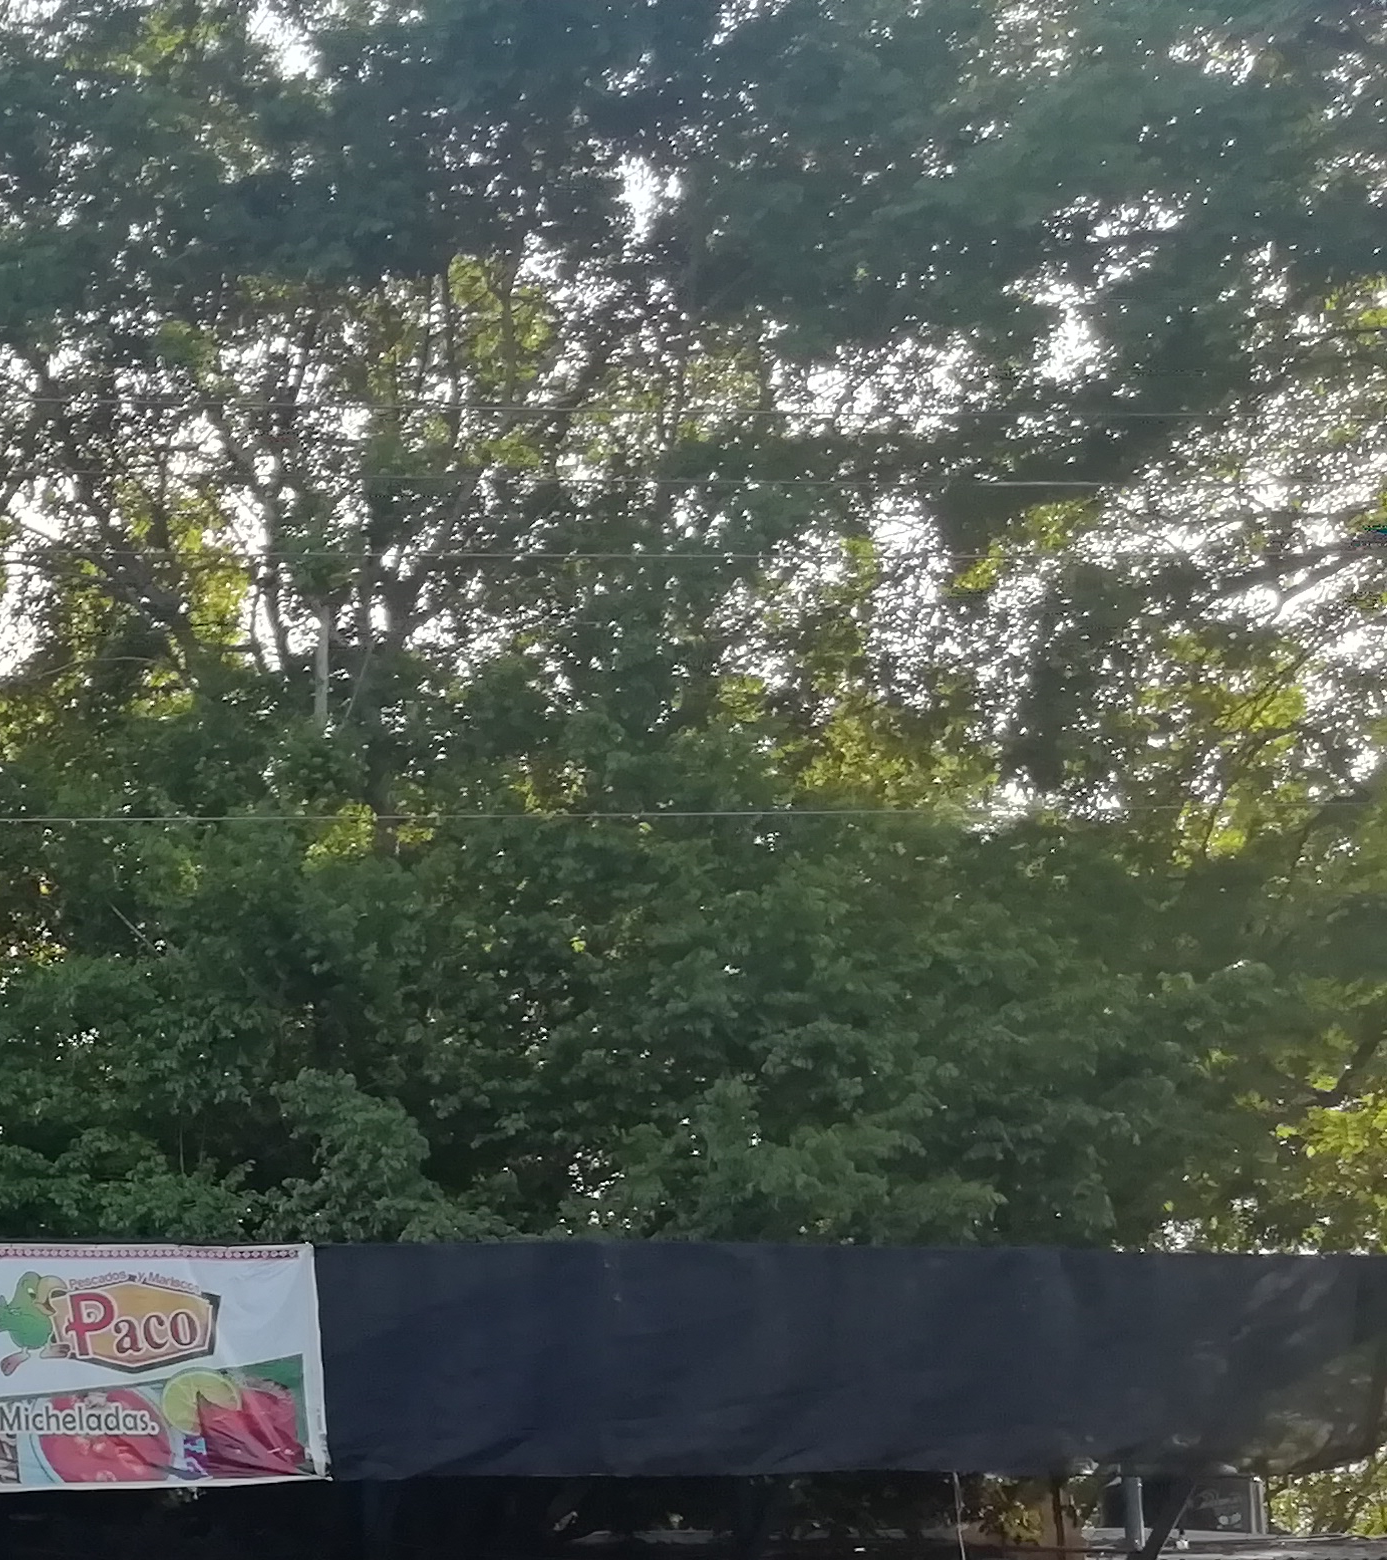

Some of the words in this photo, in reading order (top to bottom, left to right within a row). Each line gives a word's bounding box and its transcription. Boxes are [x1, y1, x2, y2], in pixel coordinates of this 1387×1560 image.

[69, 1271, 126, 1289] Pescados
[148, 1272, 200, 1293] Mariscos
[65, 1291, 199, 1356] Paco
